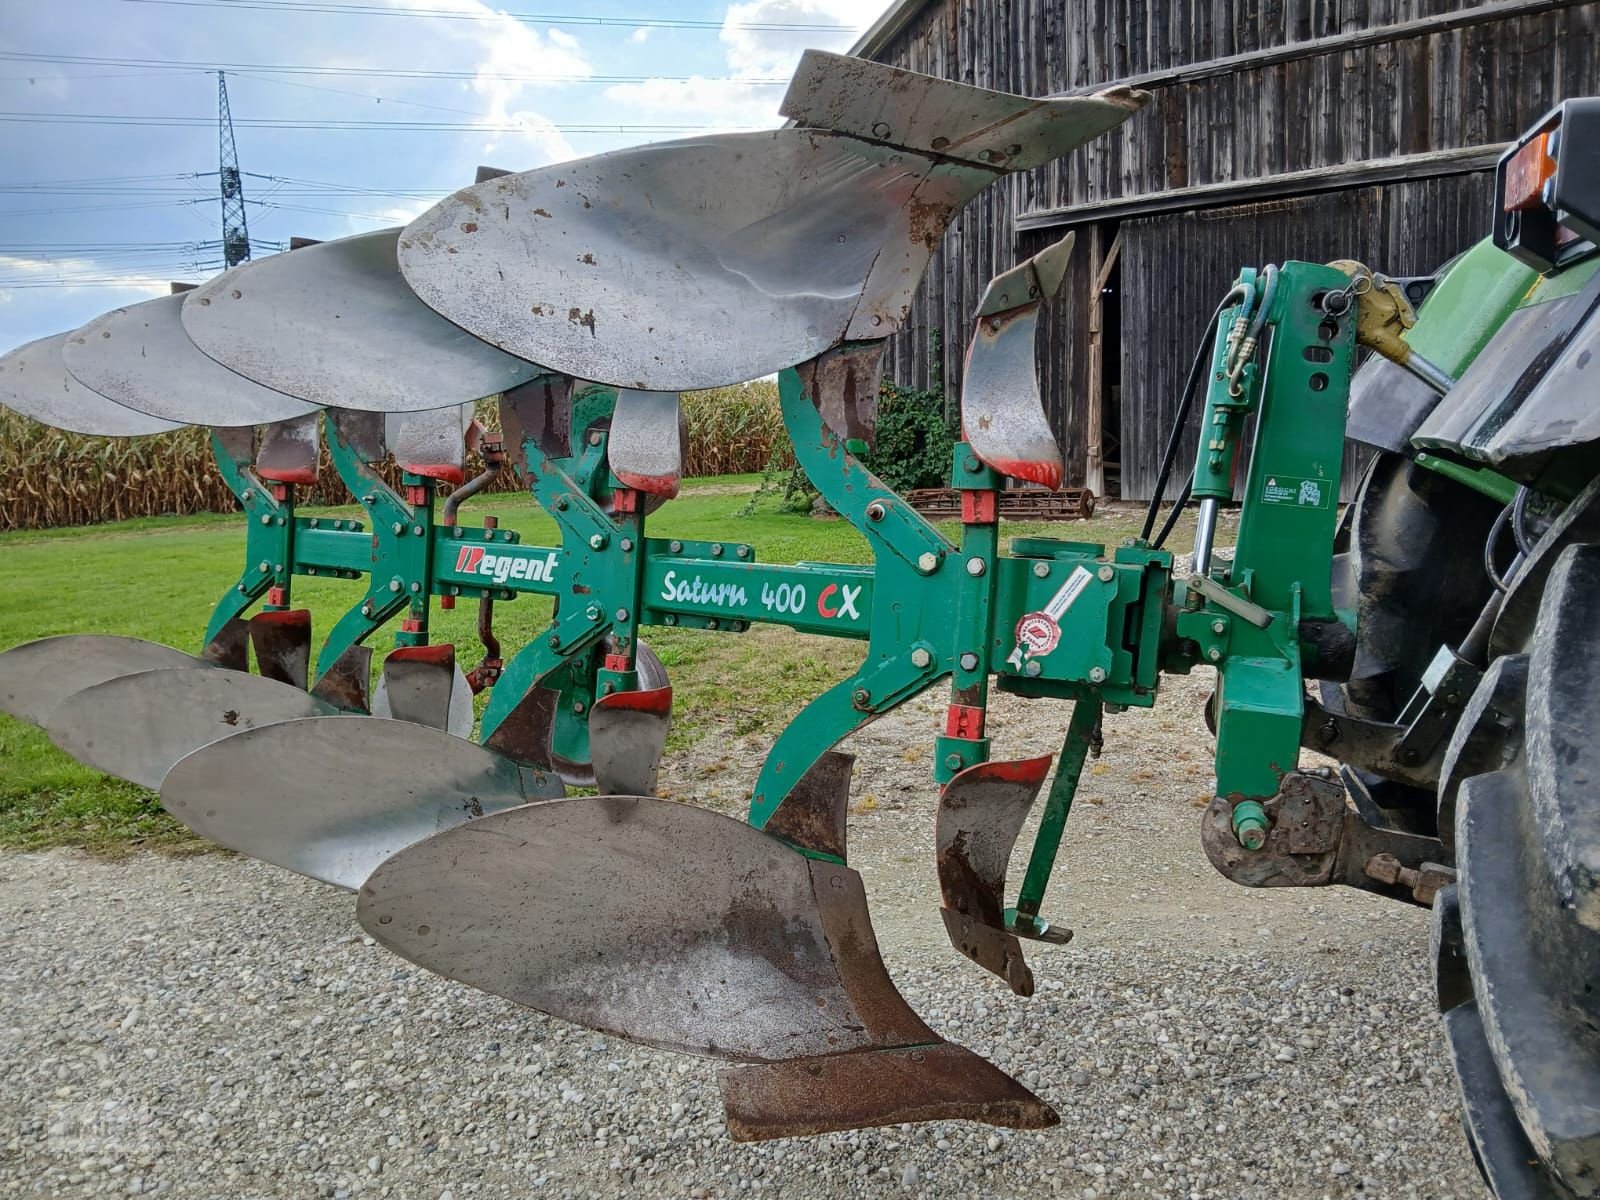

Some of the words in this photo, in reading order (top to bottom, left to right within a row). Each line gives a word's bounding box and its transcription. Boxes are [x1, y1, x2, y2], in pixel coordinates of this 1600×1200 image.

[455, 545, 560, 584] Regent
[661, 570, 748, 607] Saturn
[761, 582, 806, 614] 400
[817, 583, 862, 620] CX
